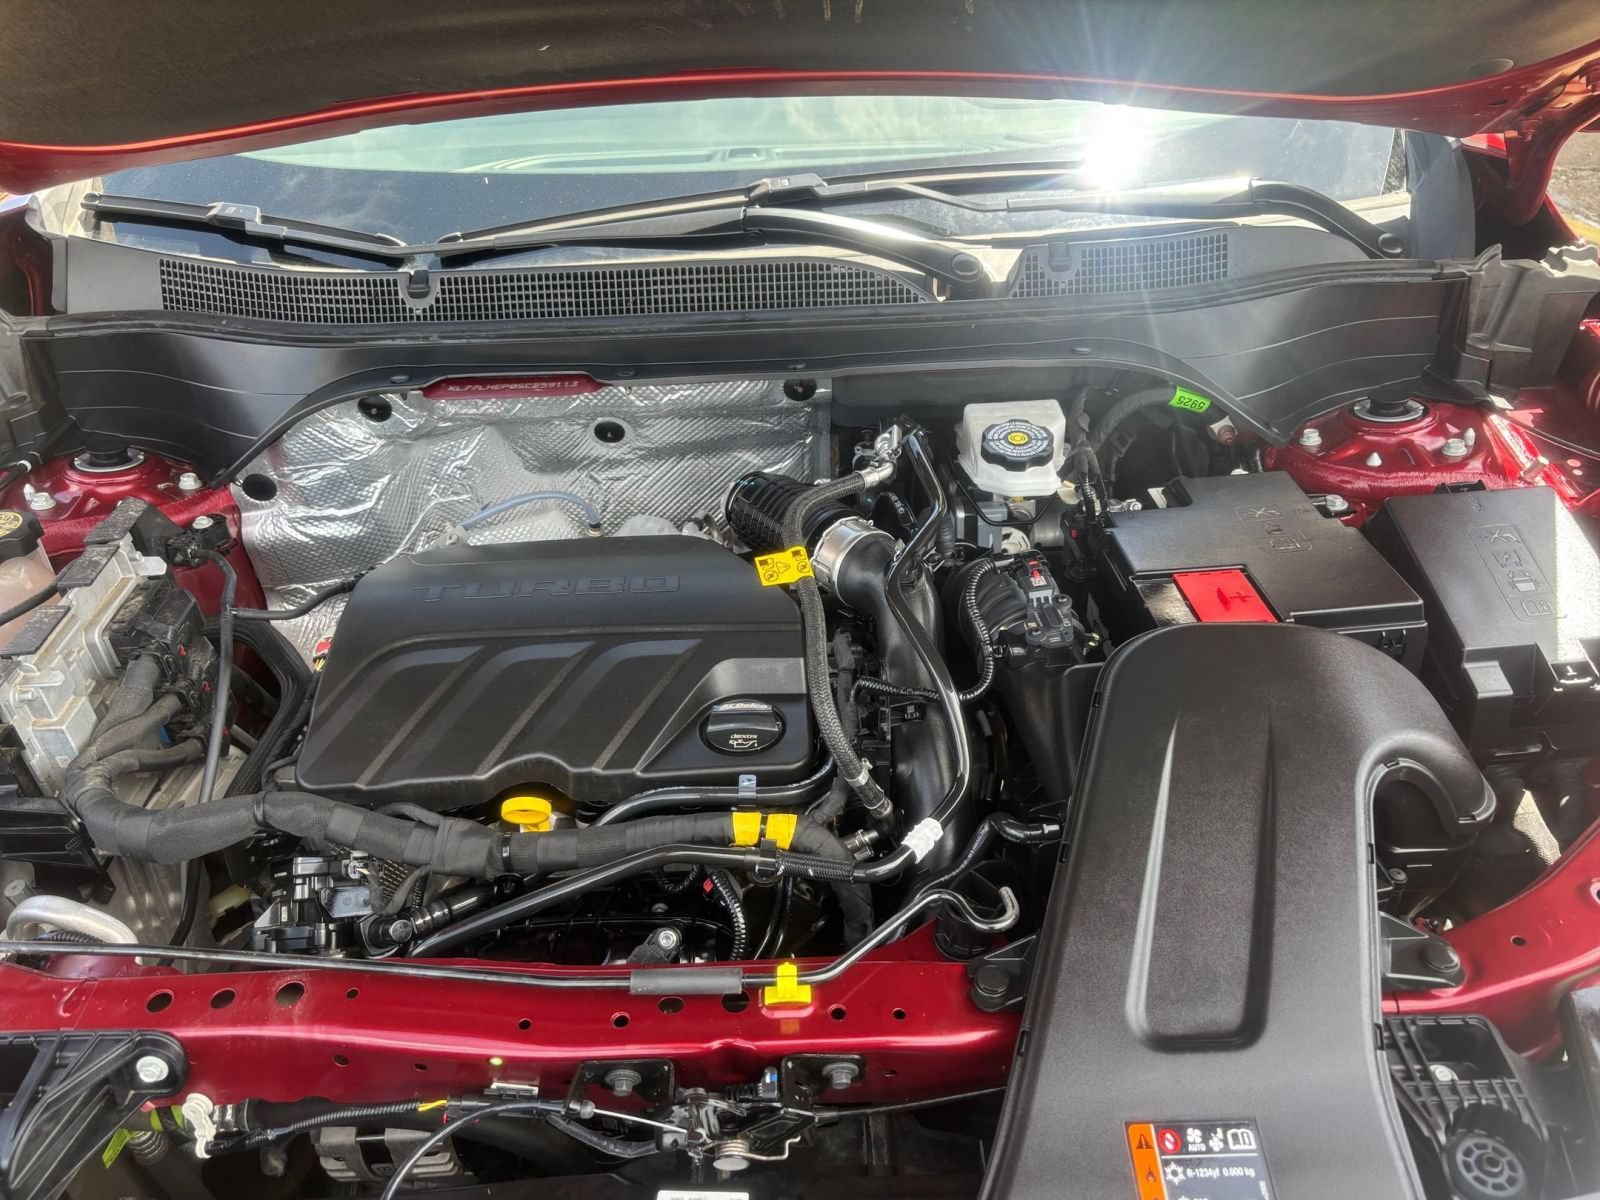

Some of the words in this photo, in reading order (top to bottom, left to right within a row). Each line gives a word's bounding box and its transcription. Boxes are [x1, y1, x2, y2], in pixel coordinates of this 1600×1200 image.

[1176, 395, 1206, 410] 5925
[411, 575, 681, 602] TURBO
[1188, 1143, 1206, 1152] AUTO
[1244, 1166, 1256, 1178] kg
